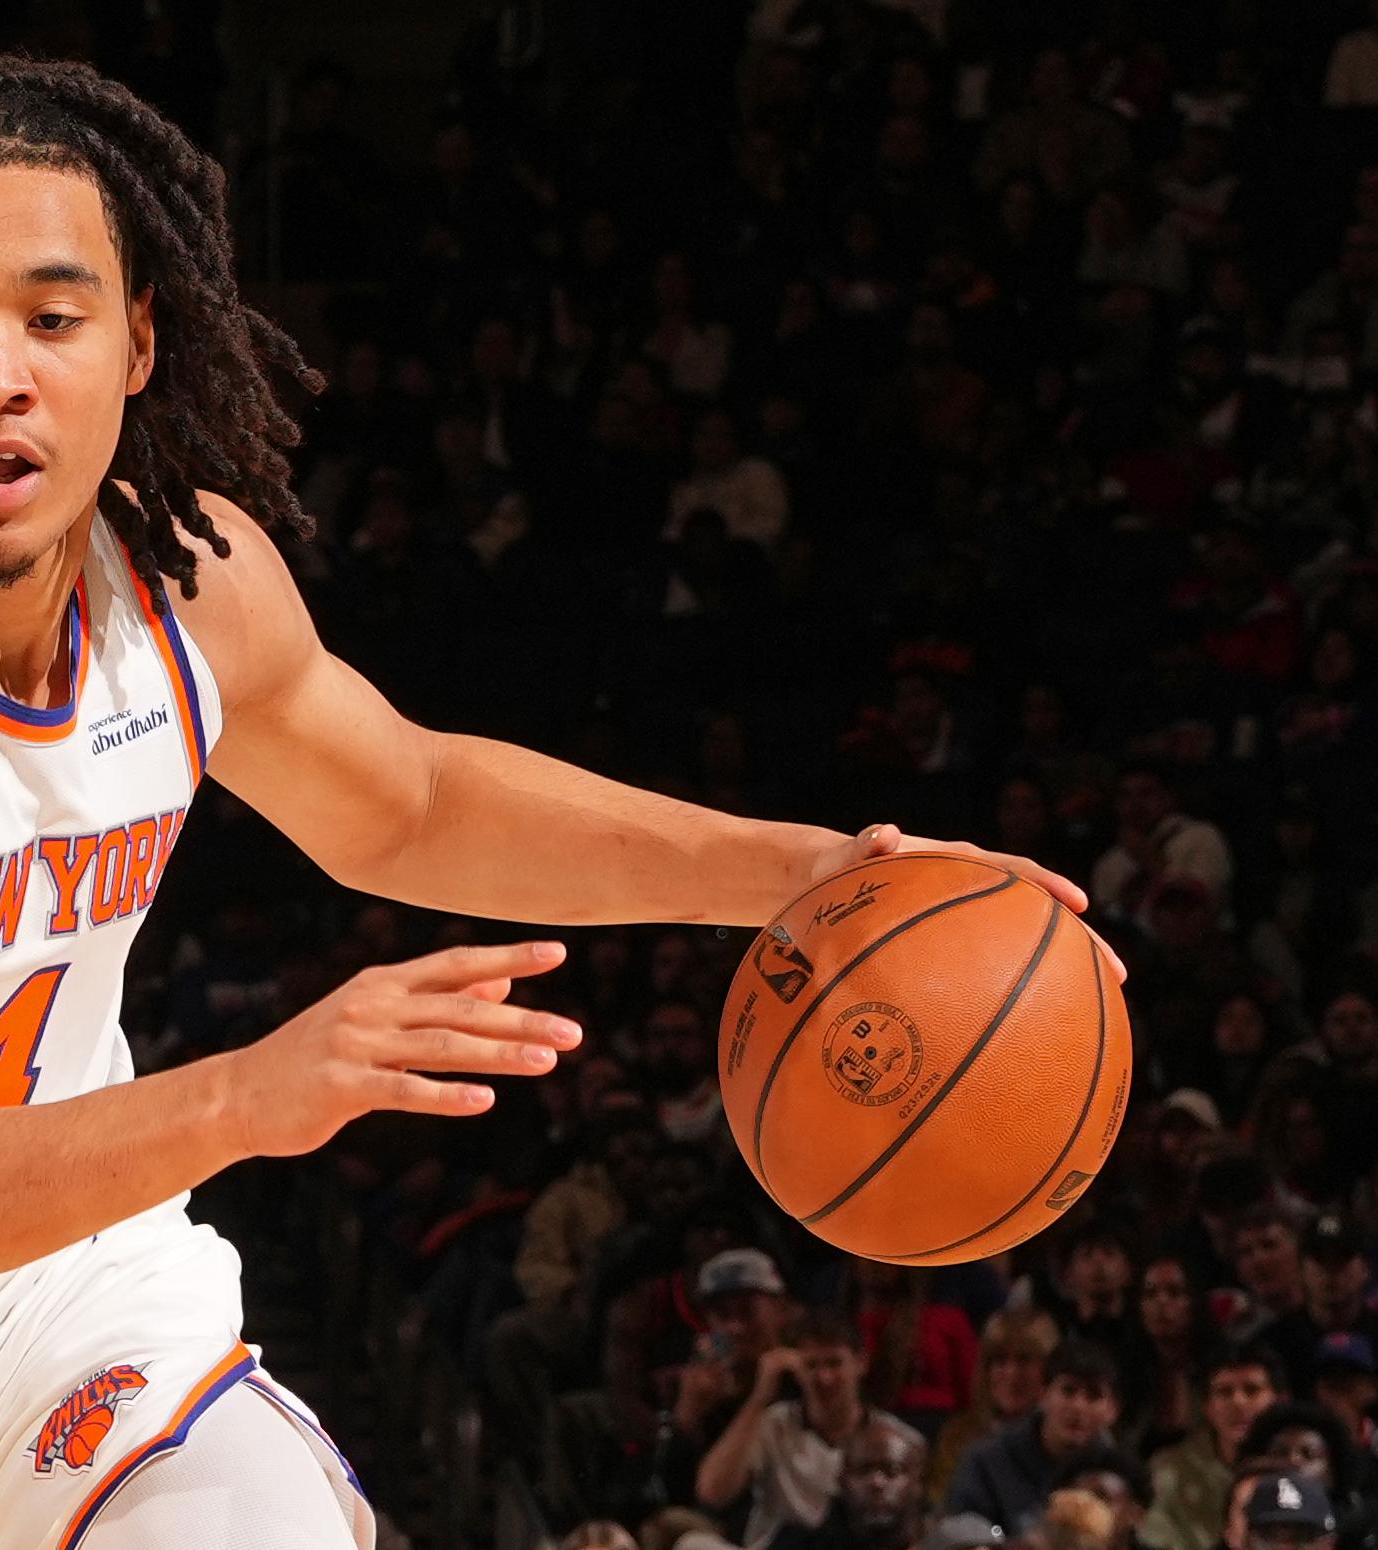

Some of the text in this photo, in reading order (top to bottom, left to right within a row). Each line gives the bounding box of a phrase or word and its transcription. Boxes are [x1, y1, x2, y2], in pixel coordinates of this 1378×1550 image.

[87, 708, 133, 733] experience
[91, 703, 169, 756] abu dhabi
[35, 1364, 149, 1473] KNICKS
